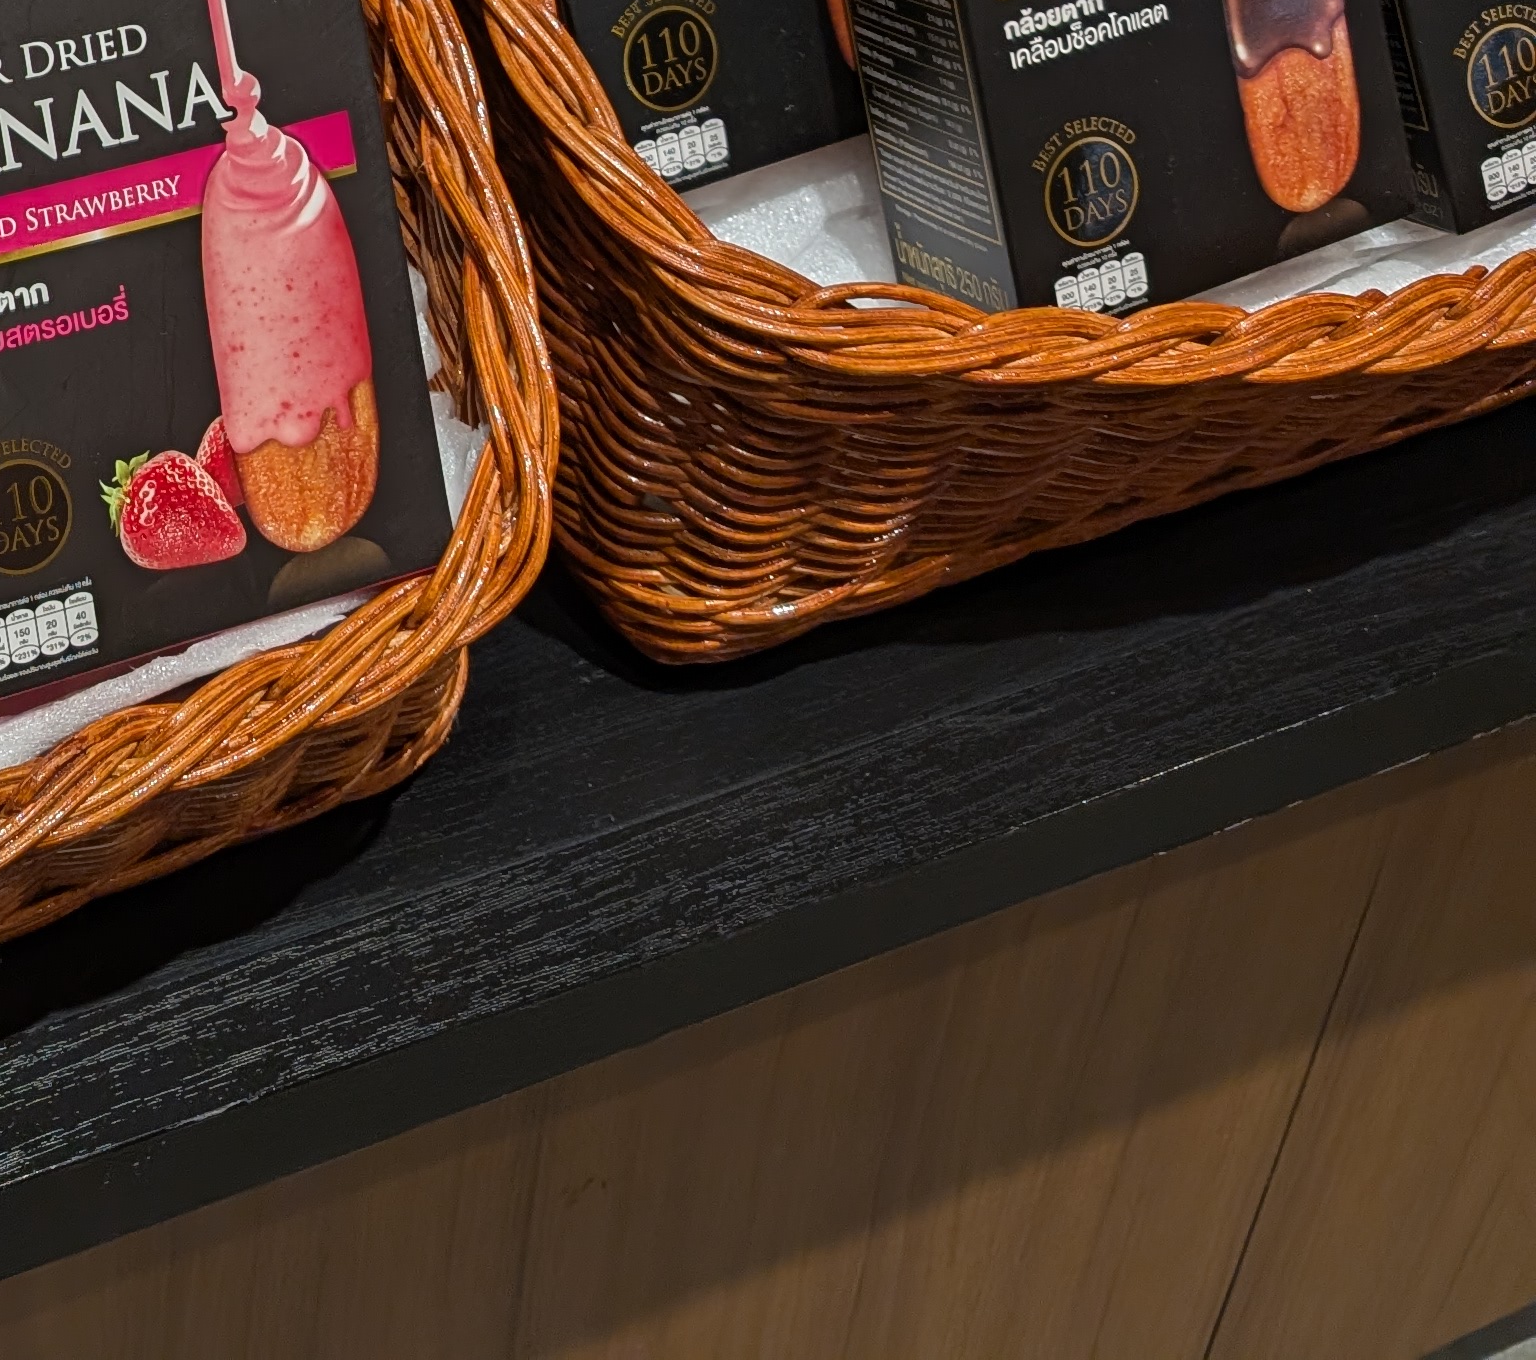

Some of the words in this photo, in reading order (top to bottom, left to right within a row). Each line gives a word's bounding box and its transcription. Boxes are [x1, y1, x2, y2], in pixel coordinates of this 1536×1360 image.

[19, 22, 149, 80] DRIED
[1009, 2, 1170, 70] เคลือบช็อคโกแลต
